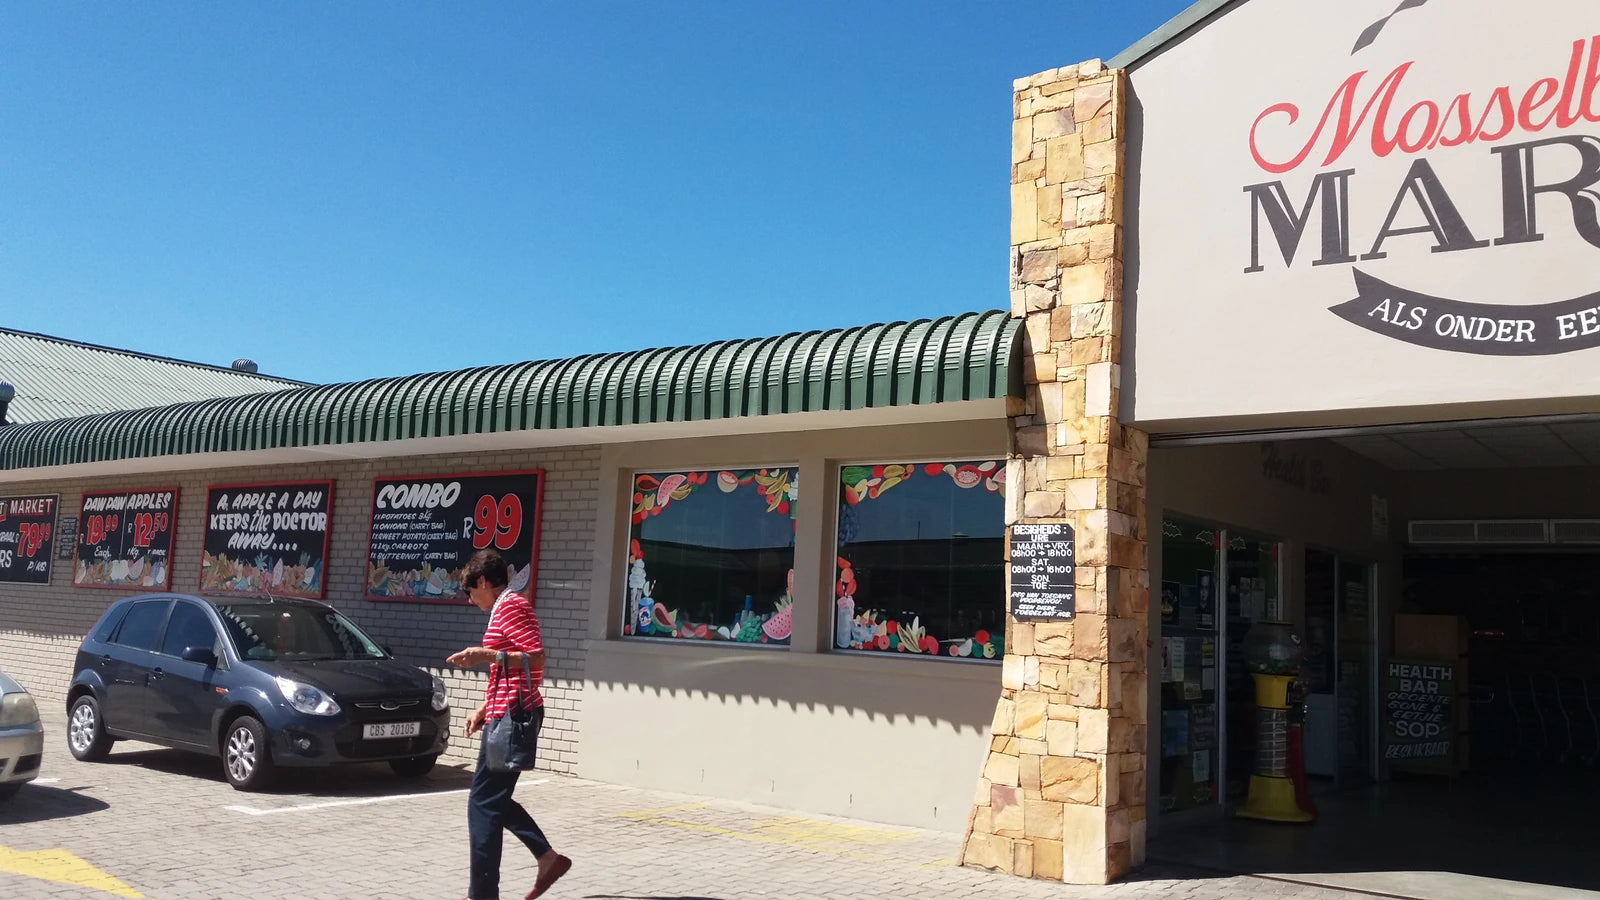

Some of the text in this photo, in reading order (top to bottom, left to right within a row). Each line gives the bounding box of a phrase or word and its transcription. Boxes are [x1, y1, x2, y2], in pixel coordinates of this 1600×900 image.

[1368, 297, 1600, 343] ALS ONDER EE
[127, 492, 171, 509] APPLES
[232, 492, 276, 510] APPLE
[278, 492, 289, 509] A
[293, 491, 322, 509] DAY
[376, 481, 461, 510] COMBO
[10, 499, 53, 514] MARKET
[210, 509, 327, 532] KEEPS the DOCTOR
[463, 493, 522, 550] R 99
[1031, 534, 1049, 542] URE
[1389, 663, 1452, 681] HEALTH
[1399, 678, 1439, 694] BAR
[369, 725, 385, 736] CBS
